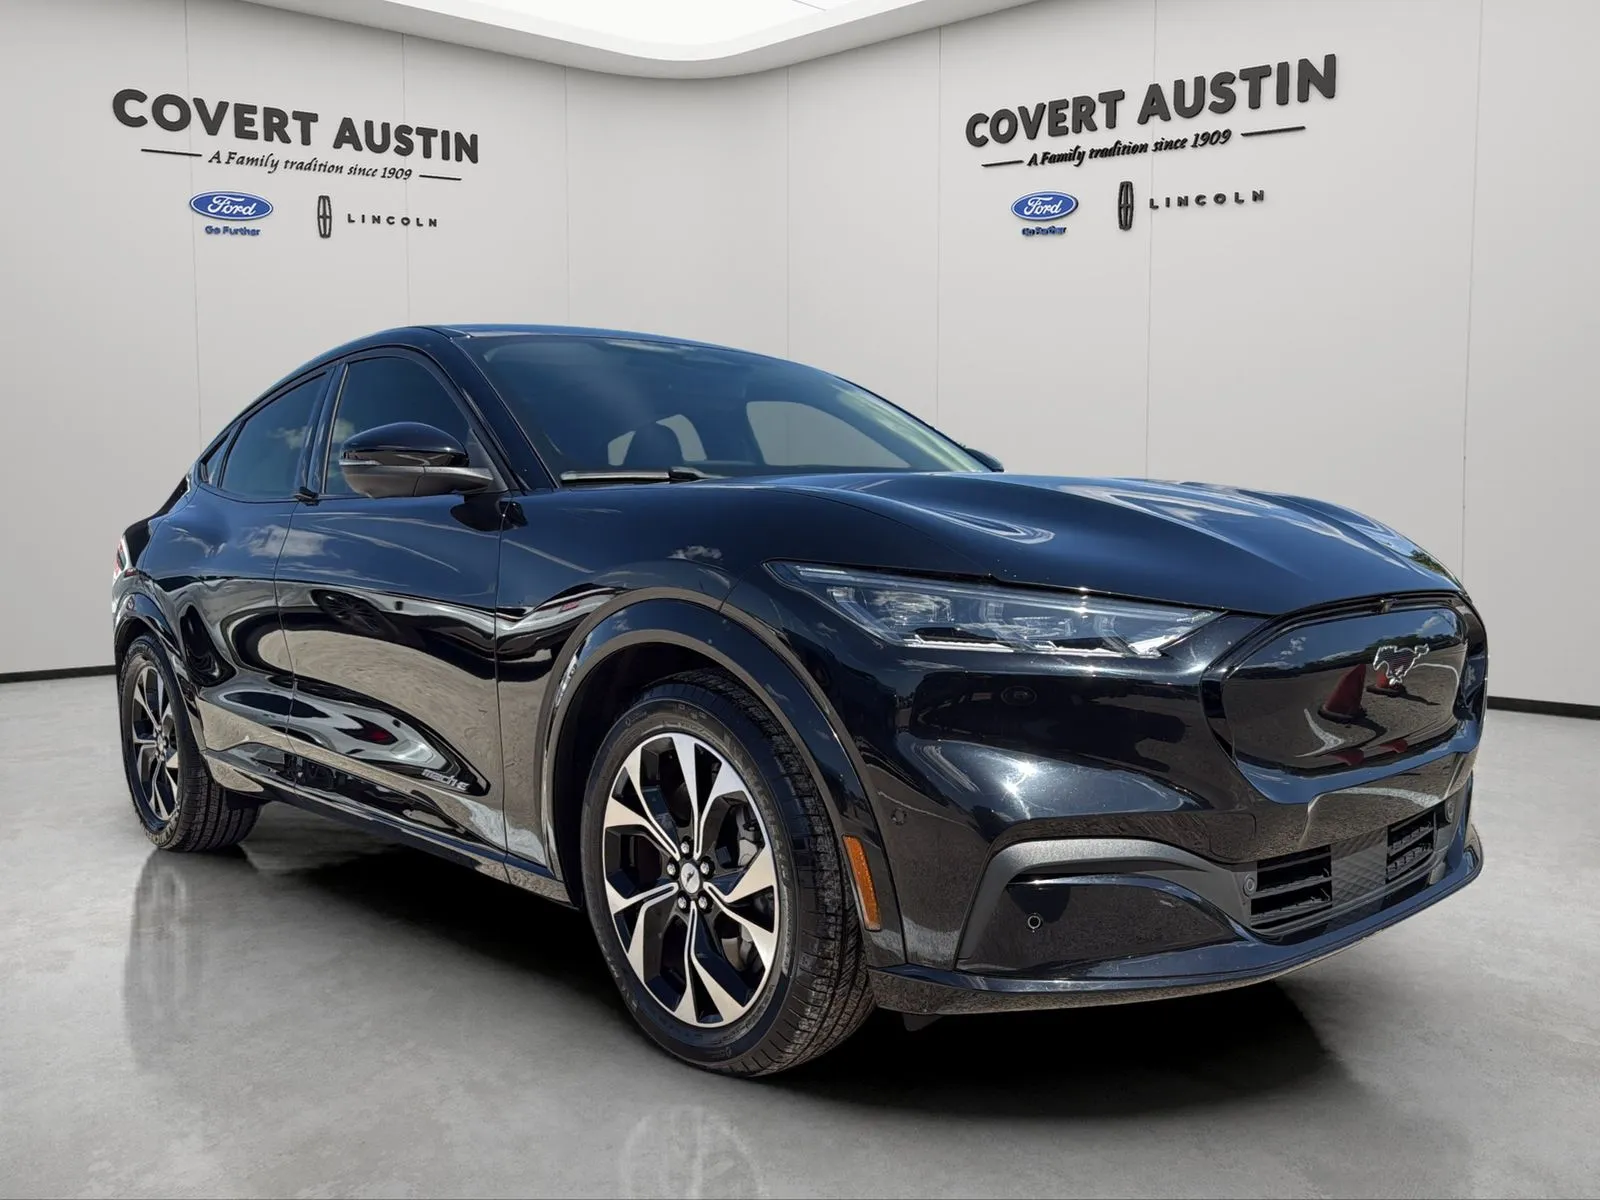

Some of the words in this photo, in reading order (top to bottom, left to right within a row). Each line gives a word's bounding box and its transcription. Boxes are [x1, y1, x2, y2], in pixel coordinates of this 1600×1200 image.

[965, 88, 1126, 149] COVERT
[1136, 53, 1337, 126] AUSTIN
[111, 88, 319, 147] COVERT
[332, 116, 479, 165] AUSTIN
[1026, 152, 1039, 168] A
[1039, 145, 1086, 168] Family
[1088, 139, 1149, 160] tradition
[1151, 136, 1189, 152] since
[1190, 128, 1233, 149] 1909
[207, 150, 222, 165] A
[224, 151, 280, 174] Family
[283, 157, 344, 176] tradition
[347, 163, 379, 179] since
[380, 166, 413, 182] 1909
[207, 195, 258, 216] Ford
[1023, 196, 1064, 216] Ford
[1149, 189, 1265, 211] LINCOLN
[347, 213, 439, 228] LINCOLN
